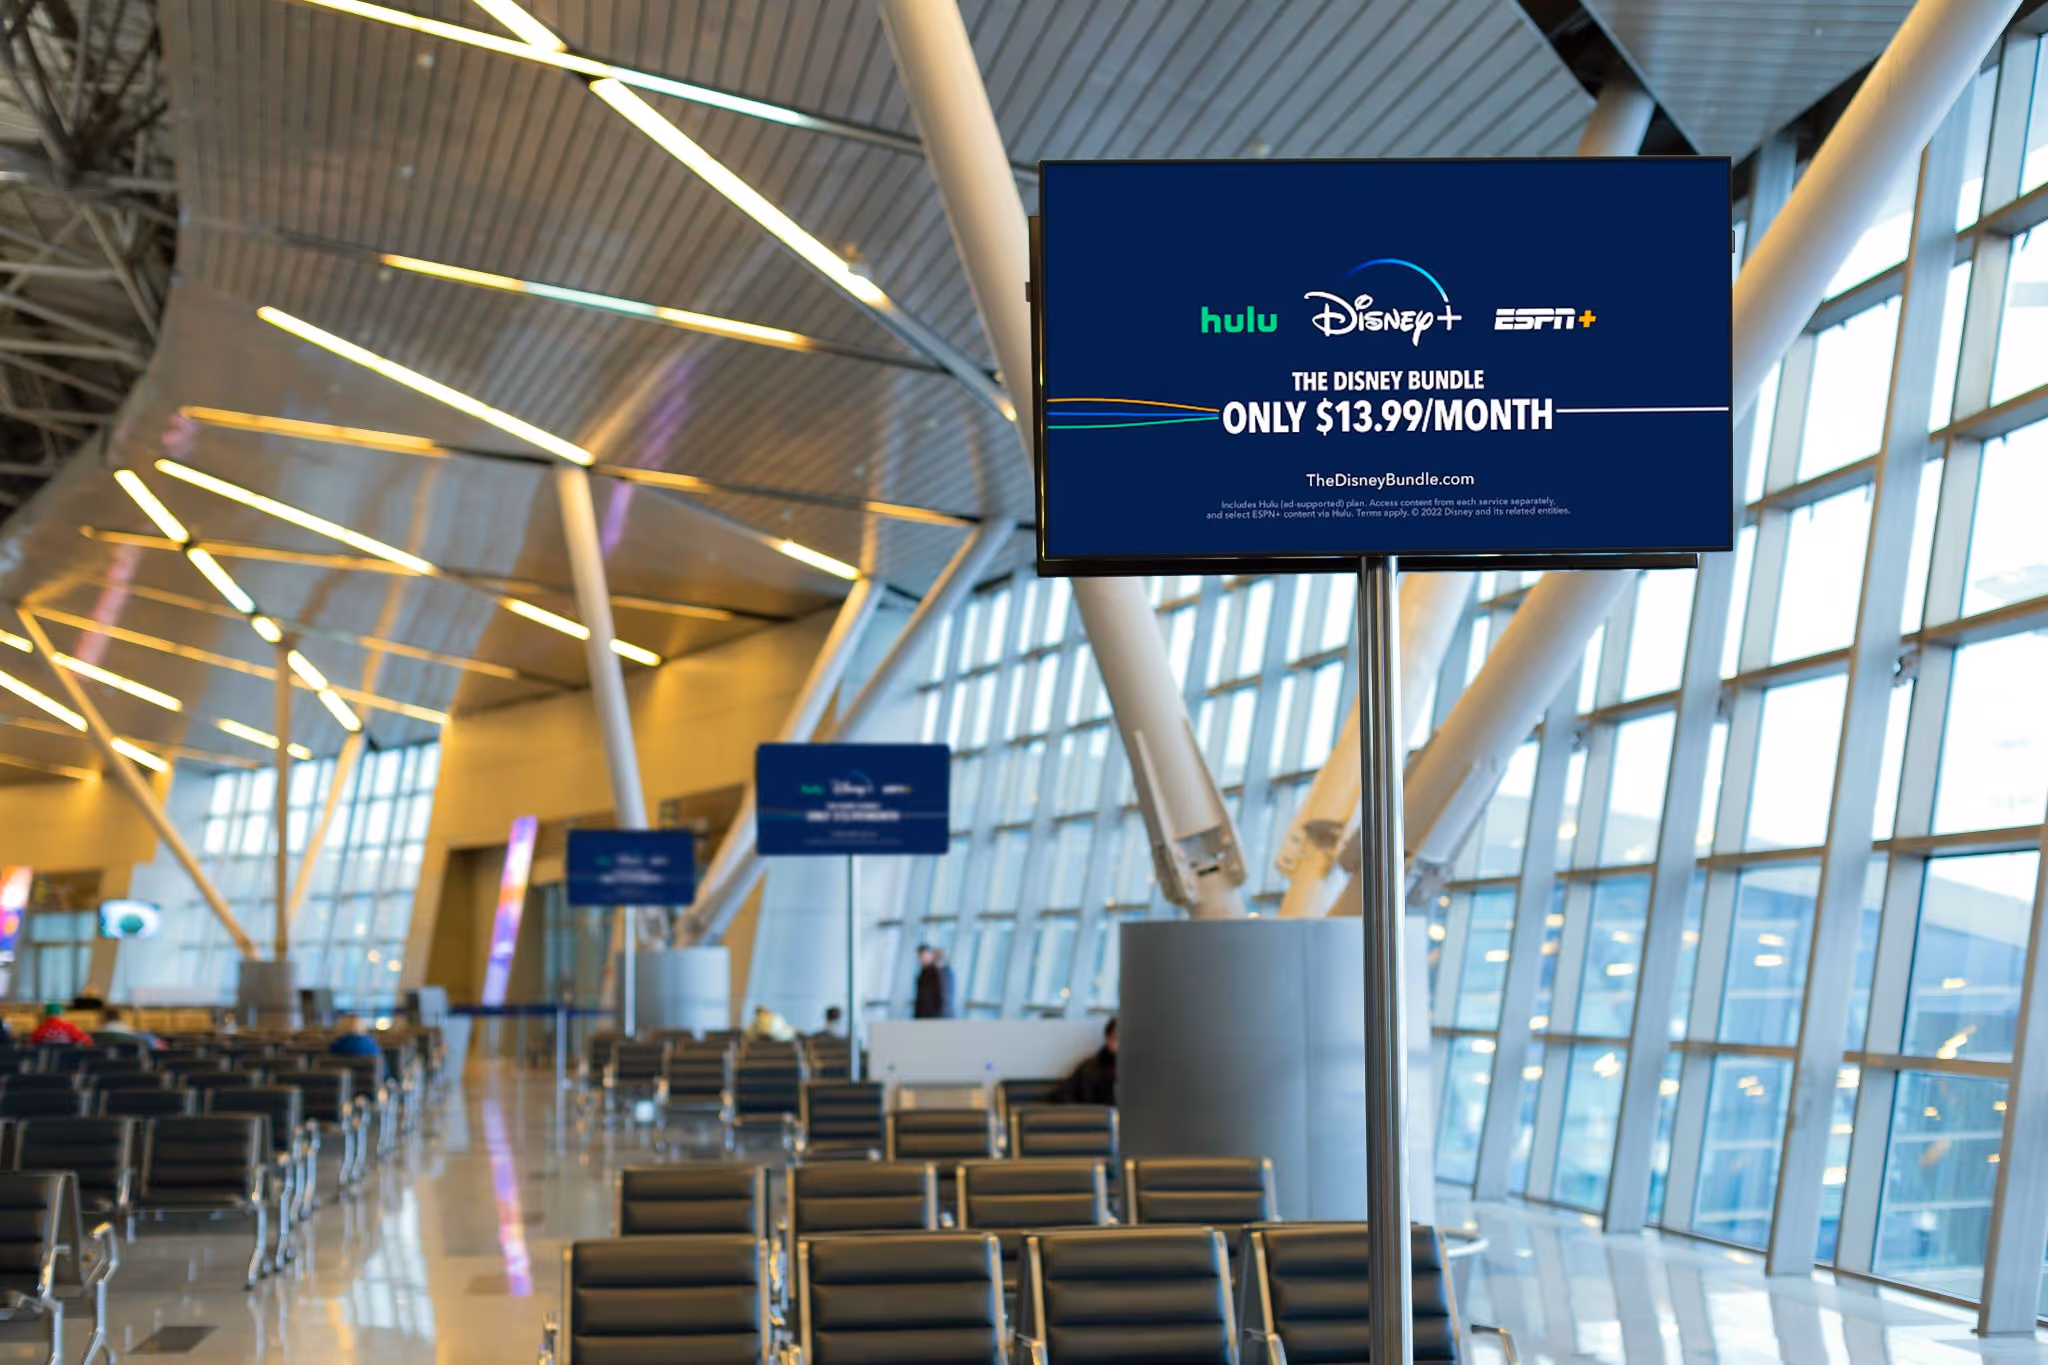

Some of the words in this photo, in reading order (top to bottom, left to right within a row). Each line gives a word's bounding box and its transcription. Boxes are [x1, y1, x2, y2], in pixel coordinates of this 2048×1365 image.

[1201, 305, 1278, 334] hulu
[1304, 288, 1462, 347] Disney+
[1494, 307, 1597, 331] ESPN+
[1292, 371, 1328, 391] THE
[1333, 371, 1403, 391] DISNEY
[1409, 370, 1485, 390] BUNDLE
[1223, 401, 1306, 434] ONLY
[1315, 398, 1553, 436] $13.99/MONTH
[1306, 472, 1475, 490] TheDisneyBundle.com
[1206, 510, 1224, 519] and
[1225, 509, 1250, 519] select
[1252, 509, 1281, 519] ESPN+
[1283, 509, 1316, 518] content
[1317, 509, 1330, 518] via
[1331, 508, 1354, 518] Hulu.
[1356, 508, 1382, 517] Terms
[1383, 508, 1410, 518] apply.
[1421, 507, 1443, 516] 2022
[1445, 507, 1473, 517] Disney
[1475, 506, 1492, 516] and
[1493, 507, 1504, 515] its
[1505, 506, 1536, 515] related
[1537, 506, 1571, 515] entities.
[1221, 500, 1257, 509] Includes
[1259, 500, 1279, 509] Hulu
[1346, 499, 1367, 509] plan.
[1369, 498, 1398, 507] Access
[1400, 498, 1433, 507] content
[1434, 498, 1455, 506] from
[1457, 497, 1477, 506] each
[1479, 498, 1508, 506] service
[1510, 496, 1557, 508] separately,
